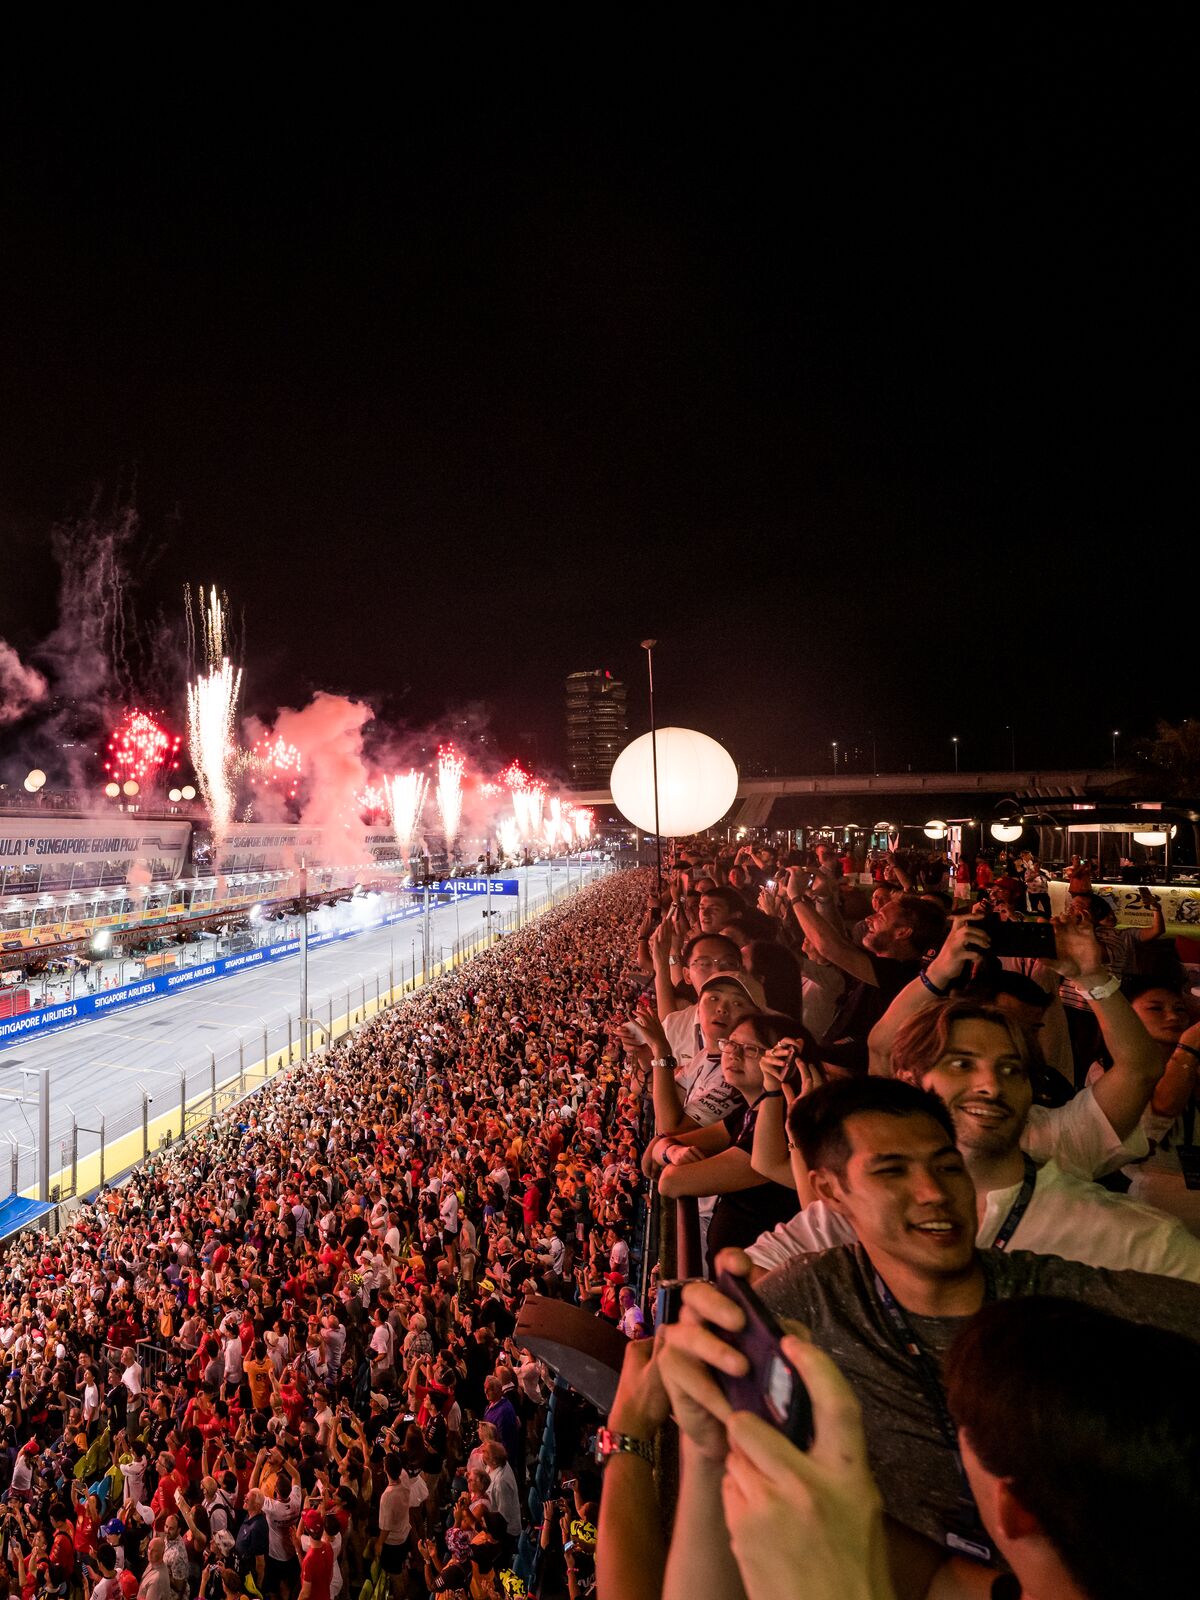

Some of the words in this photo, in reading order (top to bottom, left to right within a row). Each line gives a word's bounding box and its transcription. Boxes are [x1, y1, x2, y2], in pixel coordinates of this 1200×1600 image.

[35, 838, 90, 855] SINGAPORE
[91, 838, 120, 853] GRAND
[120, 837, 141, 852] PRIX
[167, 971, 193, 986] SINGAPORE
[193, 966, 213, 979] AIRLINES
[94, 990, 128, 1008] SINGAPORE
[128, 983, 152, 1000] AIRLINES
[41, 1004, 73, 1026] AIRLINES
